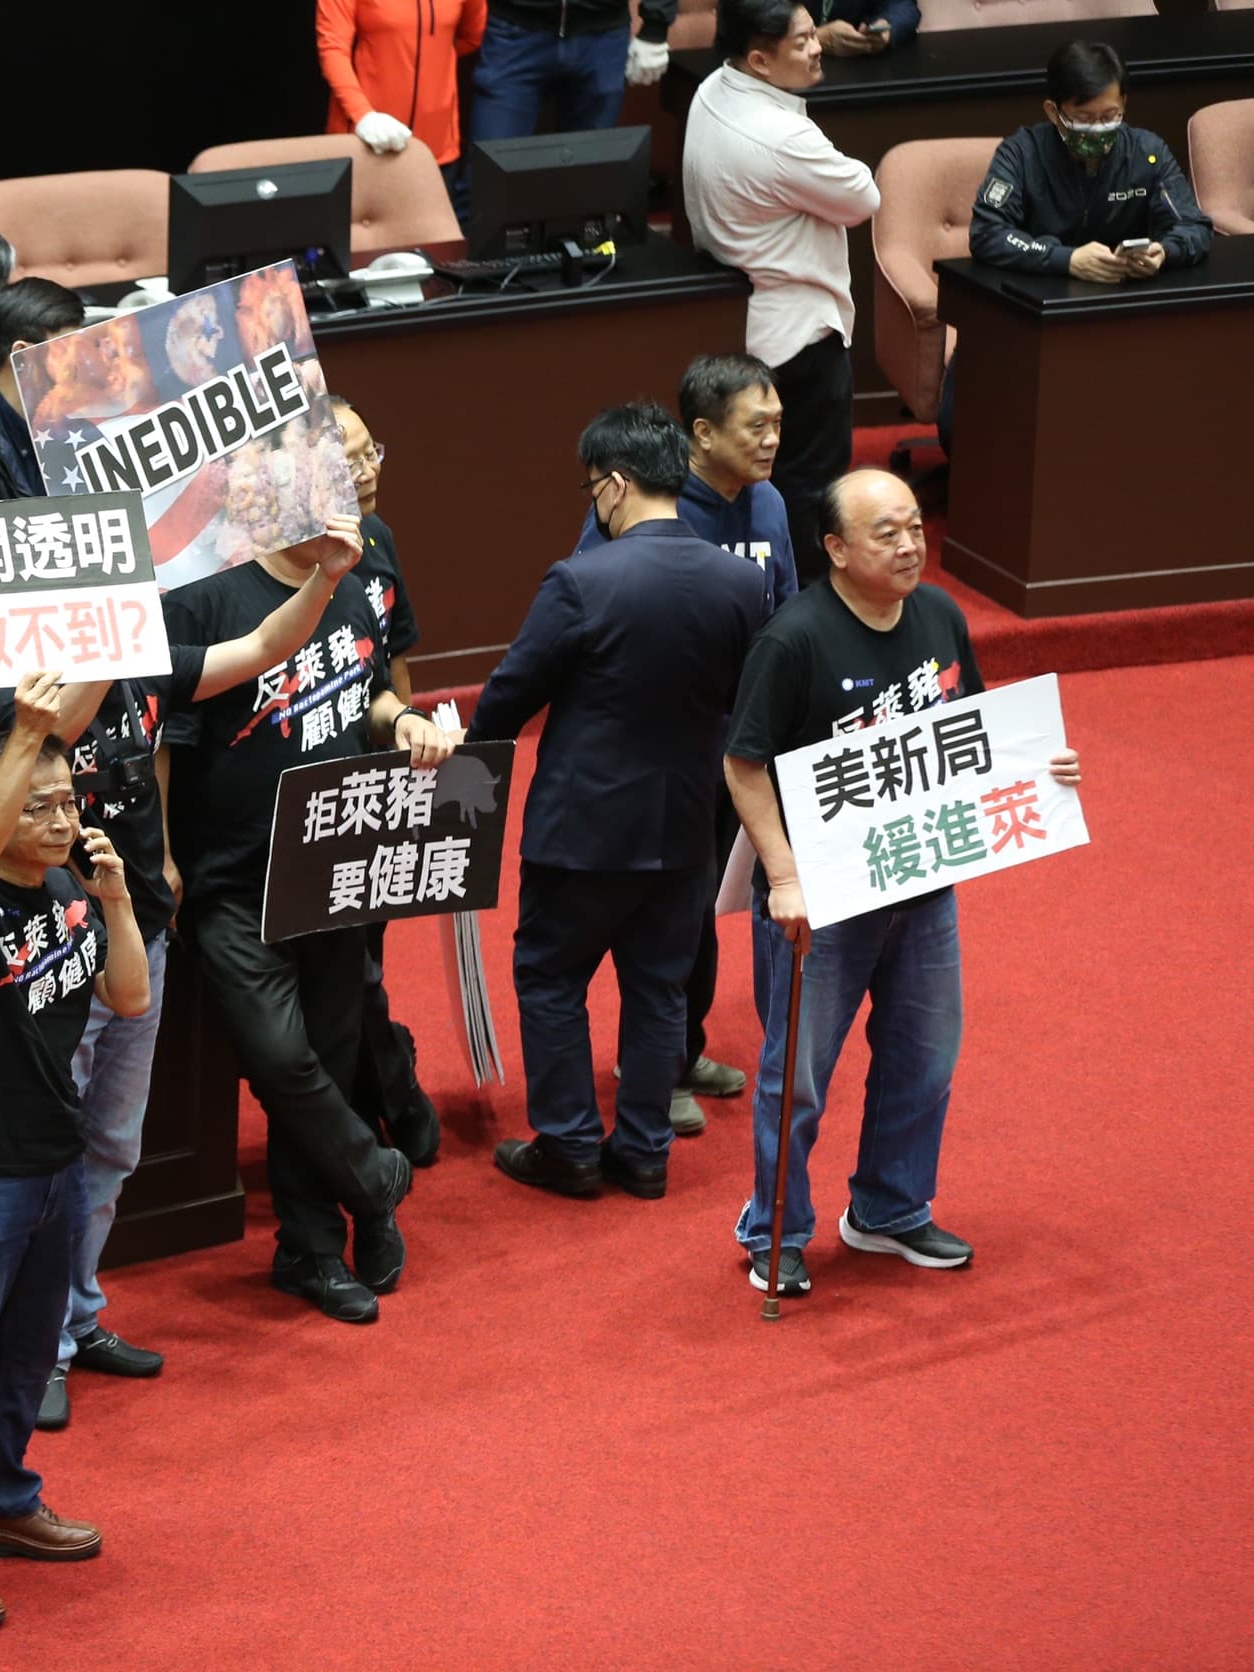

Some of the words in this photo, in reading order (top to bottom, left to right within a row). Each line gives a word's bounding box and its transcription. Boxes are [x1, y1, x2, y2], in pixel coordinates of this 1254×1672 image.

[80, 348, 305, 494] INEDIBLE
[252, 624, 359, 712] 反萊豬
[855, 678, 875, 688] KMT
[302, 767, 438, 844] 拒萊豬
[812, 709, 992, 822] 美新局
[328, 835, 471, 915] 要健康
[863, 779, 1047, 892] 緩進萊
